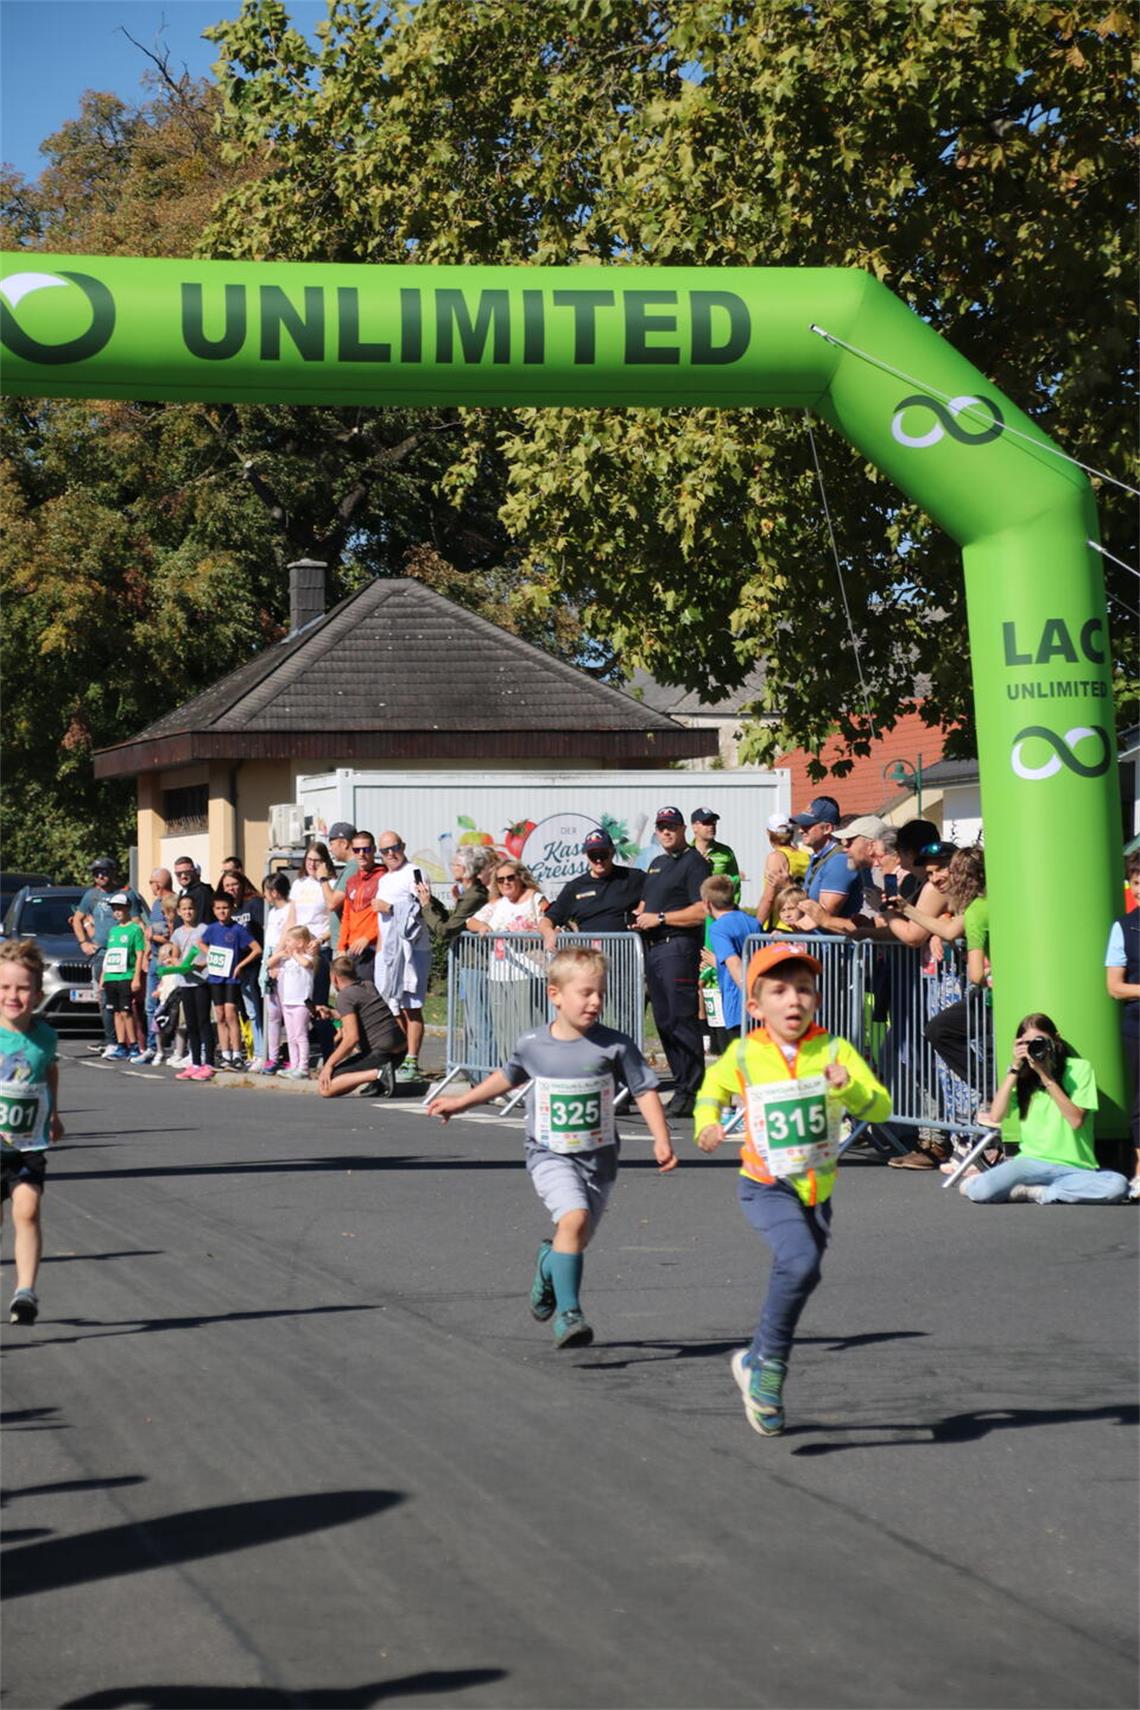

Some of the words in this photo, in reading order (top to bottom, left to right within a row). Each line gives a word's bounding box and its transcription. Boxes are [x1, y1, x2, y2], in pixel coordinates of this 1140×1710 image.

[181, 282, 752, 366] UNLIMITED
[1002, 618, 1105, 666] LAC
[1007, 681, 1108, 700] UNLIMITED
[560, 827, 577, 835] DER
[526, 859, 590, 884] Greiss
[552, 1100, 600, 1126] 325
[768, 1104, 826, 1140] 315
